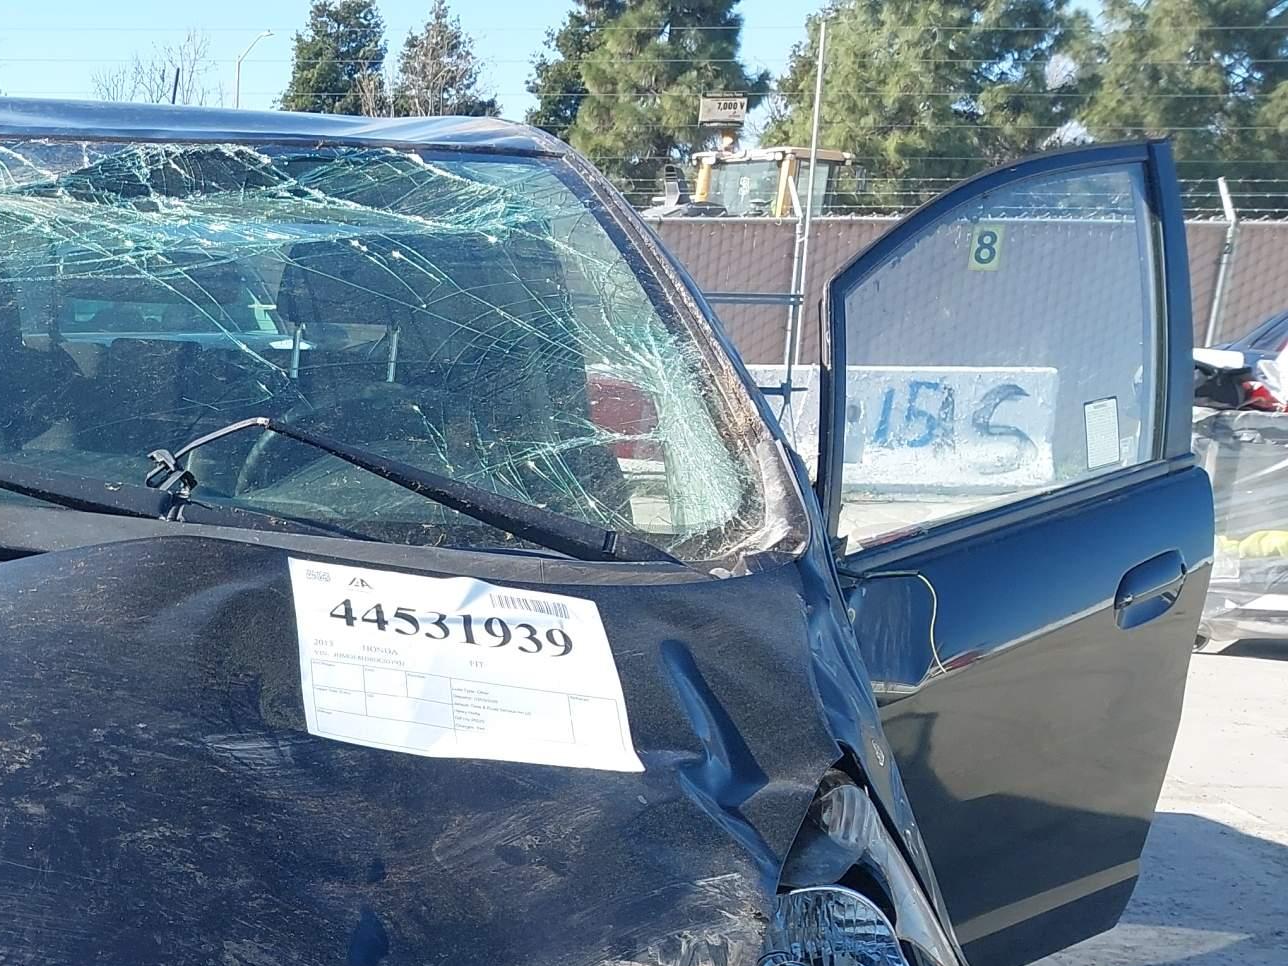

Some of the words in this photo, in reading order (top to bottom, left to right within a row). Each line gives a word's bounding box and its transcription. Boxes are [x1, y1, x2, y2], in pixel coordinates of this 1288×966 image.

[717, 102, 738, 111] 7,000
[974, 231, 998, 264] 8
[330, 598, 573, 657] 44531939
